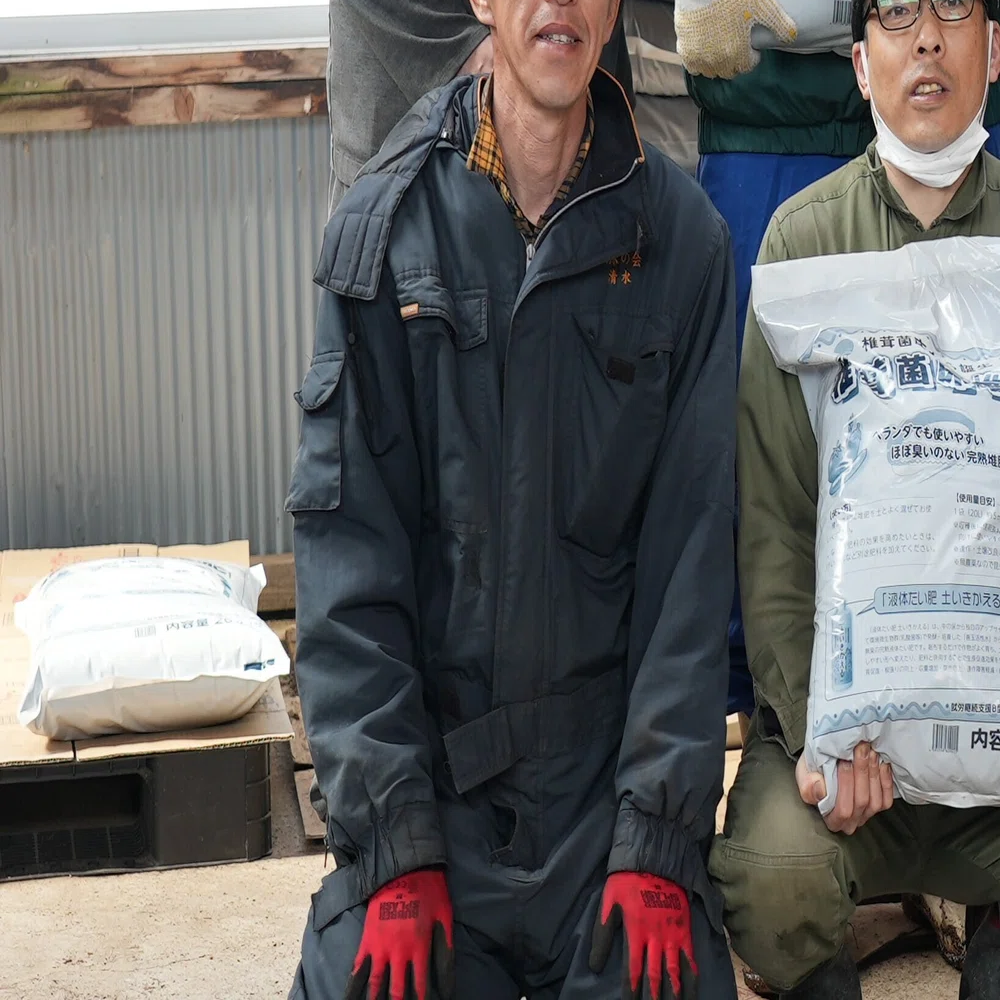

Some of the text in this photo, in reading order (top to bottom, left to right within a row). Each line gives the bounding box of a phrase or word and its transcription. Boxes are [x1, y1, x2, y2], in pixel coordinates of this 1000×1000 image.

[956, 493, 995, 507] 【使用量目安】
